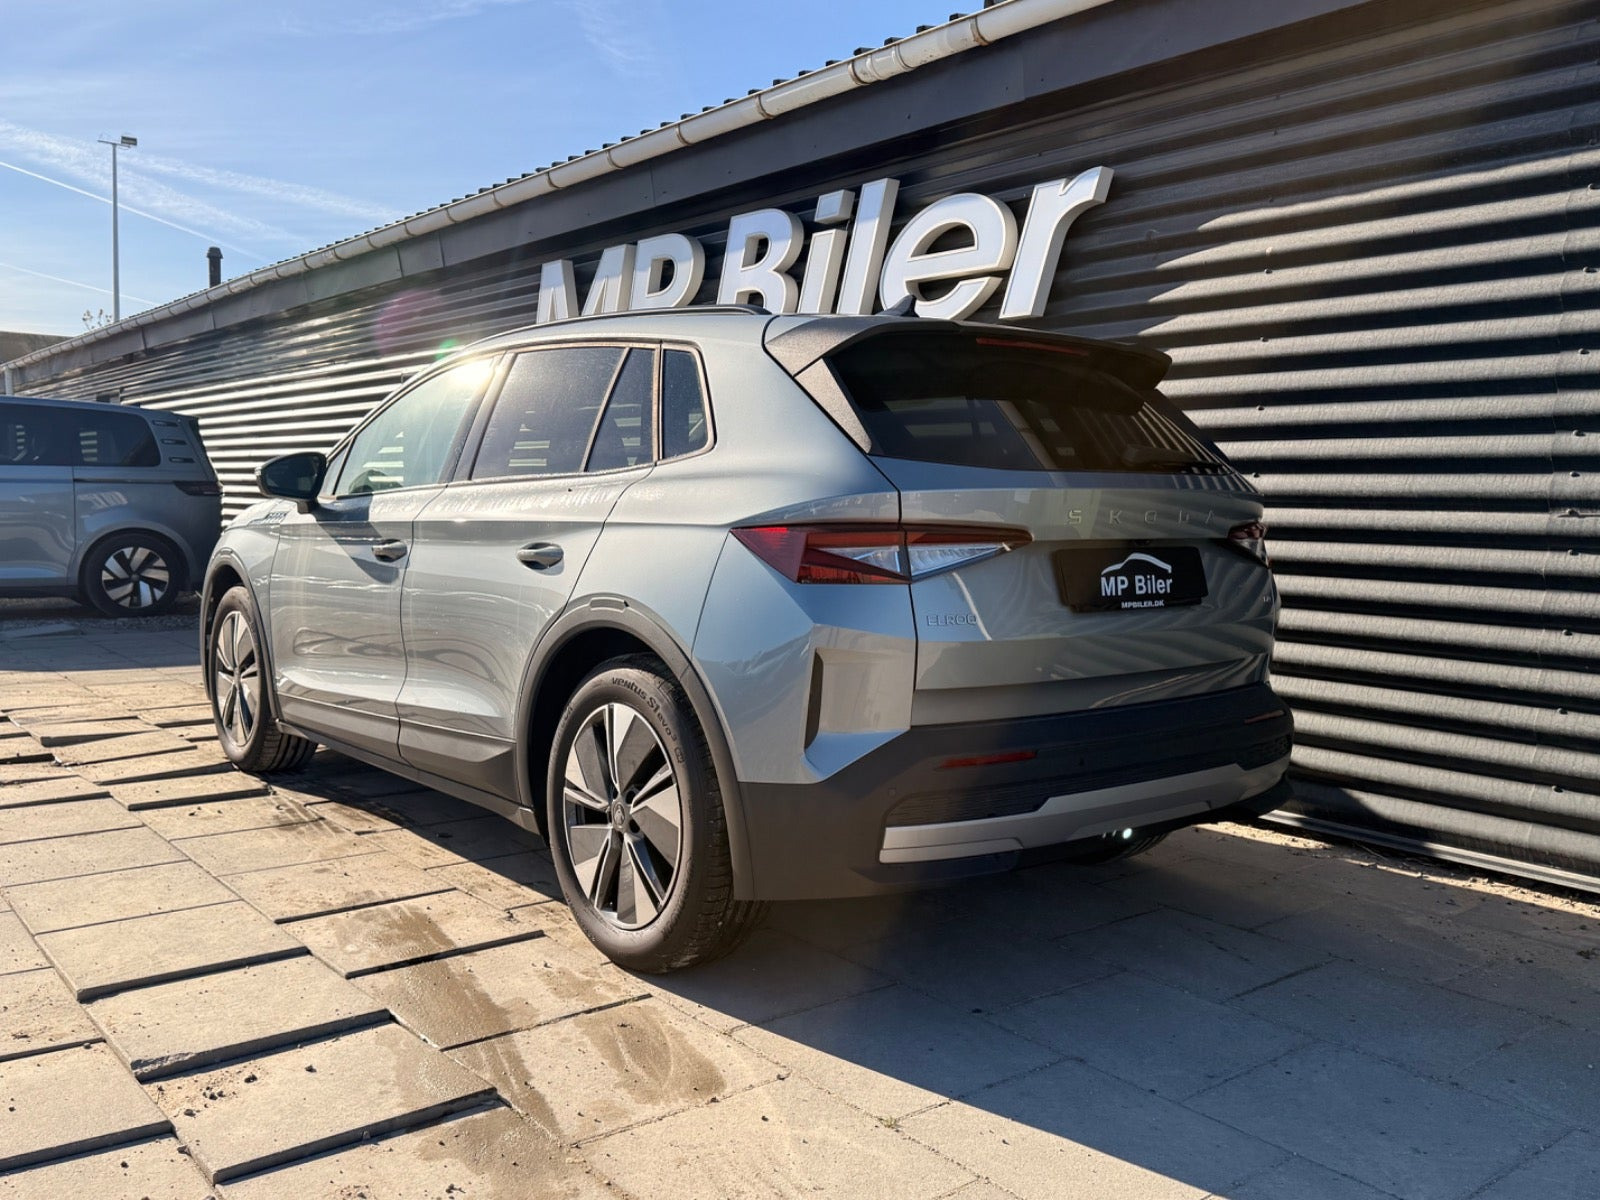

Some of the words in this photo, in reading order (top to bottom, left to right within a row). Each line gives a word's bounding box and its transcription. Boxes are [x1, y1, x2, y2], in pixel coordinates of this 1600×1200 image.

[536, 232, 705, 323] MP
[717, 165, 1114, 319] Biler
[1101, 576, 1128, 596] MP
[1134, 574, 1173, 595] Biler
[1121, 600, 1165, 609] MPBILER.DK
